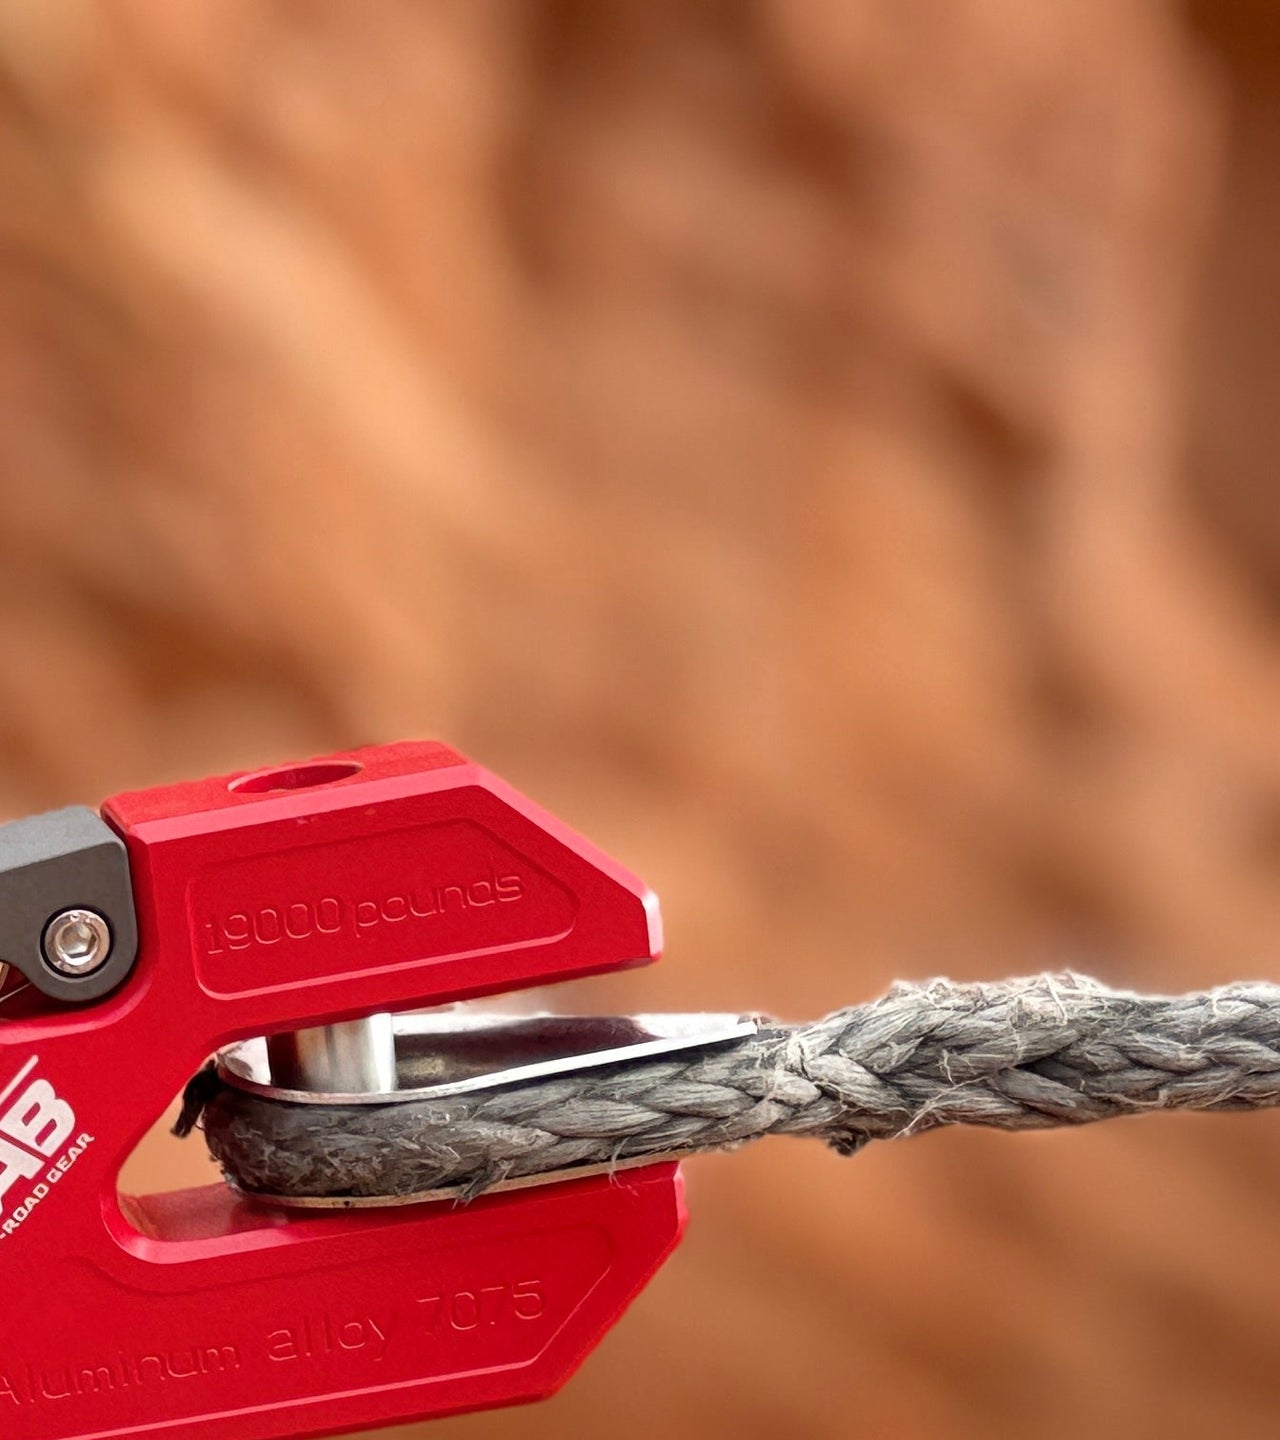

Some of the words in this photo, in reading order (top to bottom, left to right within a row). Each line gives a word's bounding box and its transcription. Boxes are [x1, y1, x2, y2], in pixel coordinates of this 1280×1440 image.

[353, 868, 523, 938] pounds
[46, 1133, 95, 1184] GEAR
[267, 1312, 388, 1361] alloy
[416, 1279, 543, 1338] 7075
